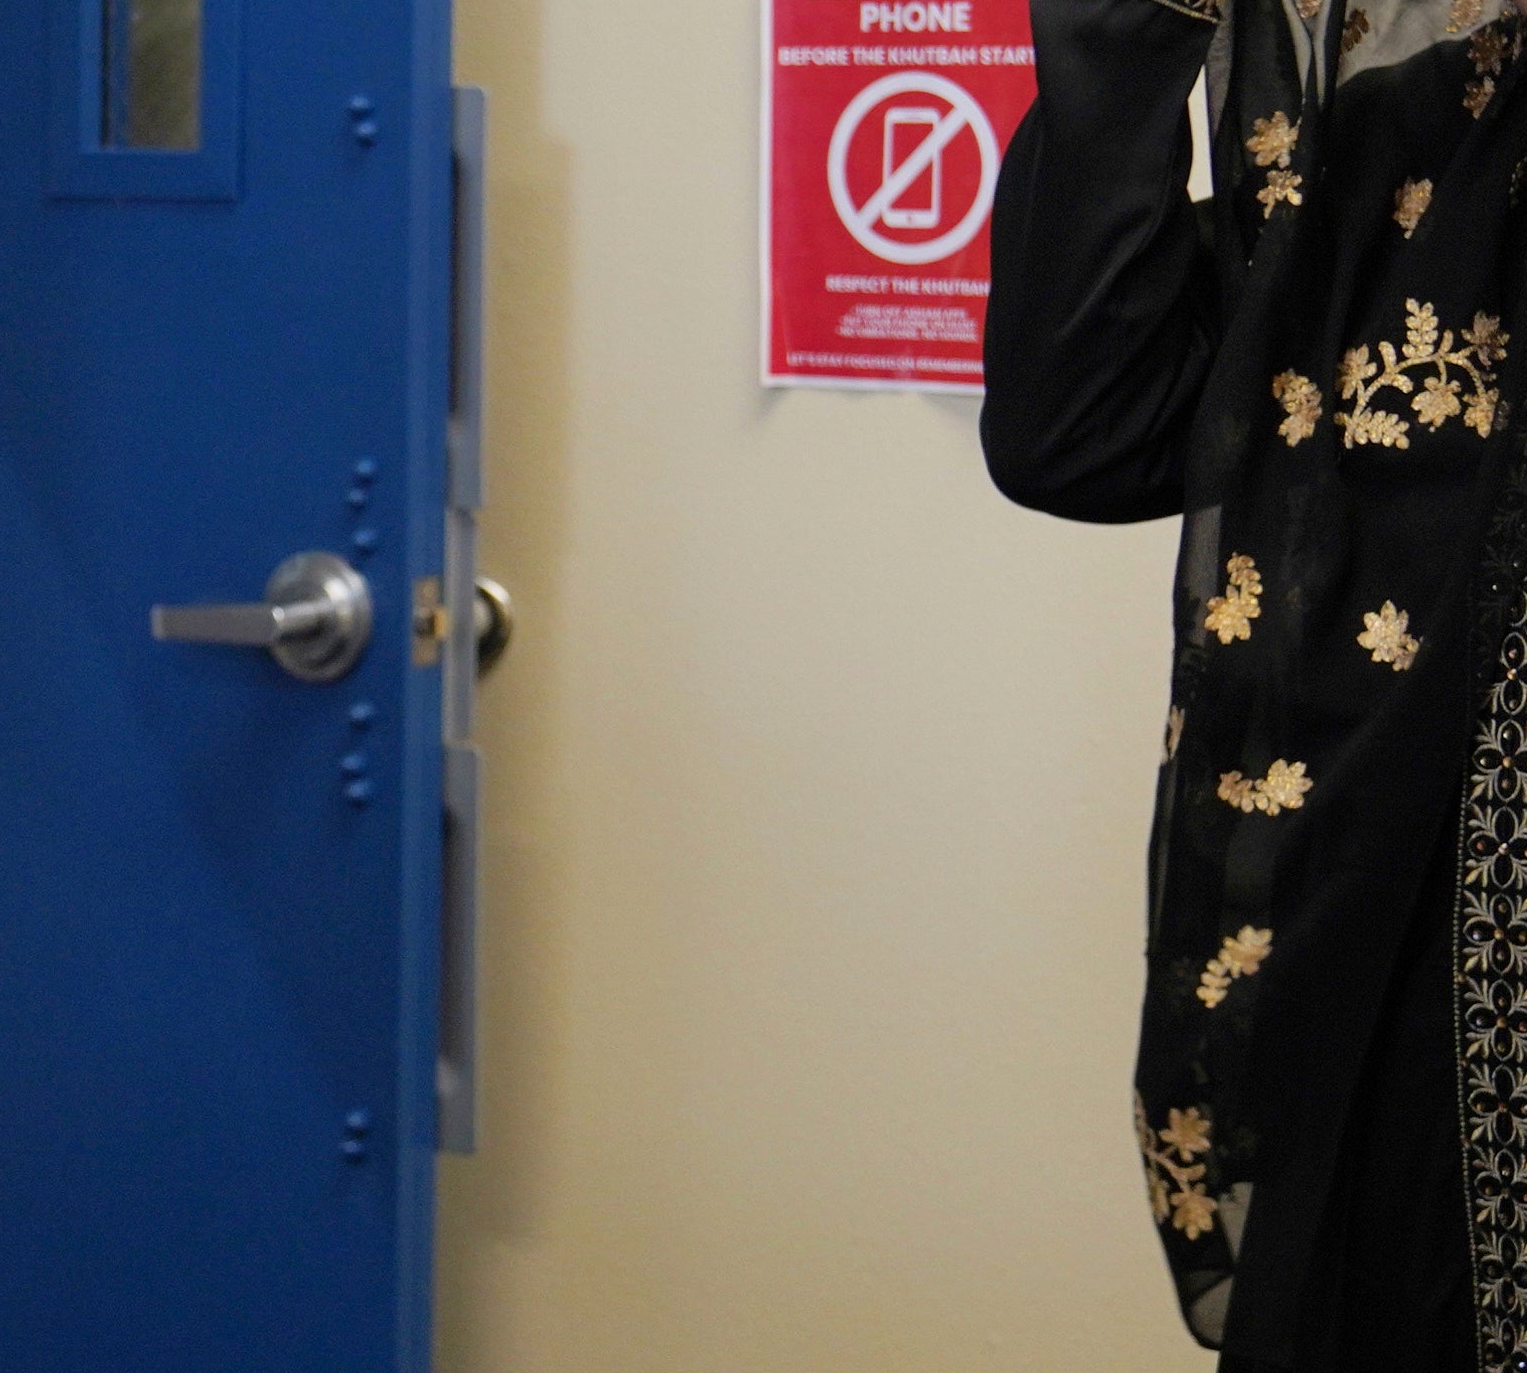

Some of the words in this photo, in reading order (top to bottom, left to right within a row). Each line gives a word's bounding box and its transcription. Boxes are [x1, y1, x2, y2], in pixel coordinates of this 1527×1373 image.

[860, 1, 972, 32] PHONE
[778, 46, 849, 66] BEFORE
[852, 47, 885, 65] THE
[888, 46, 975, 66] KHUTBAH
[826, 275, 888, 293] RESPECT
[892, 277, 920, 295] THE
